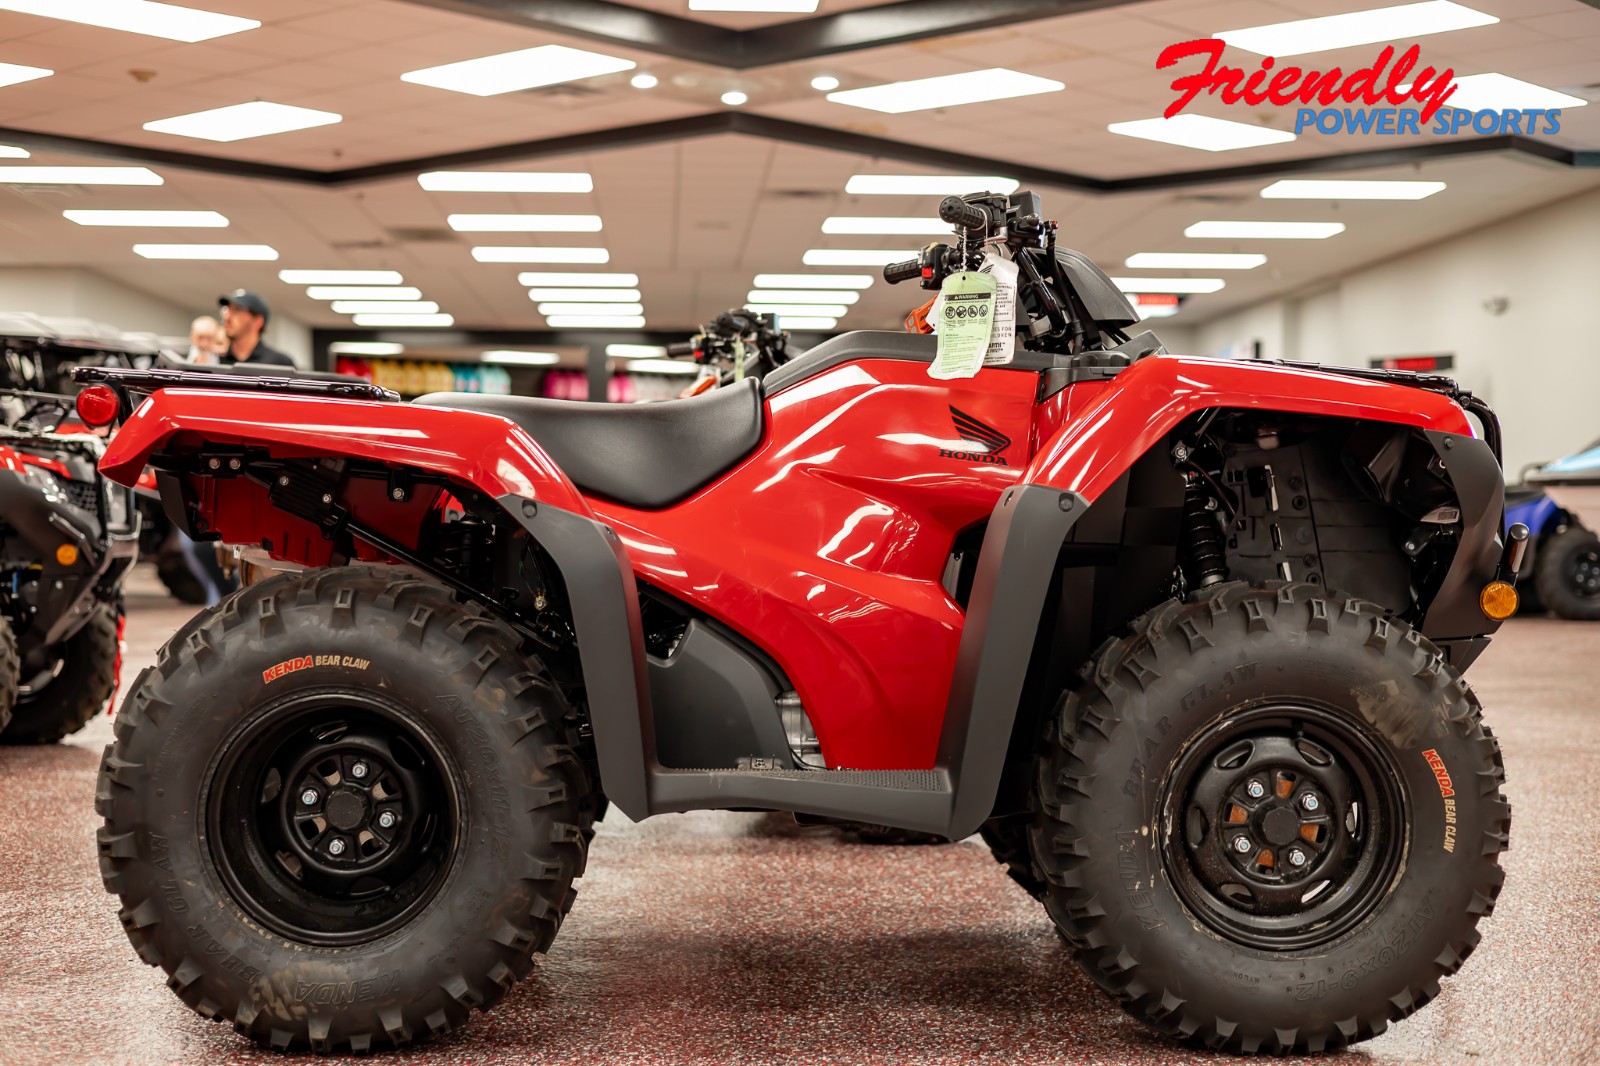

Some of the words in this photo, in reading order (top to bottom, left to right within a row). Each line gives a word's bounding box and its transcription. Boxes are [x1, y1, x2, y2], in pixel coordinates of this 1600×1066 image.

[938, 448, 1009, 467] HONDA
[262, 655, 314, 685] KENDA
[315, 655, 341, 666] BEAR
[342, 656, 370, 670] CLAW
[1422, 748, 1455, 798] KENDA
[1444, 798, 1456, 824] BEAR
[1443, 825, 1457, 853] CLAW
[294, 969, 402, 1005] KENDA
